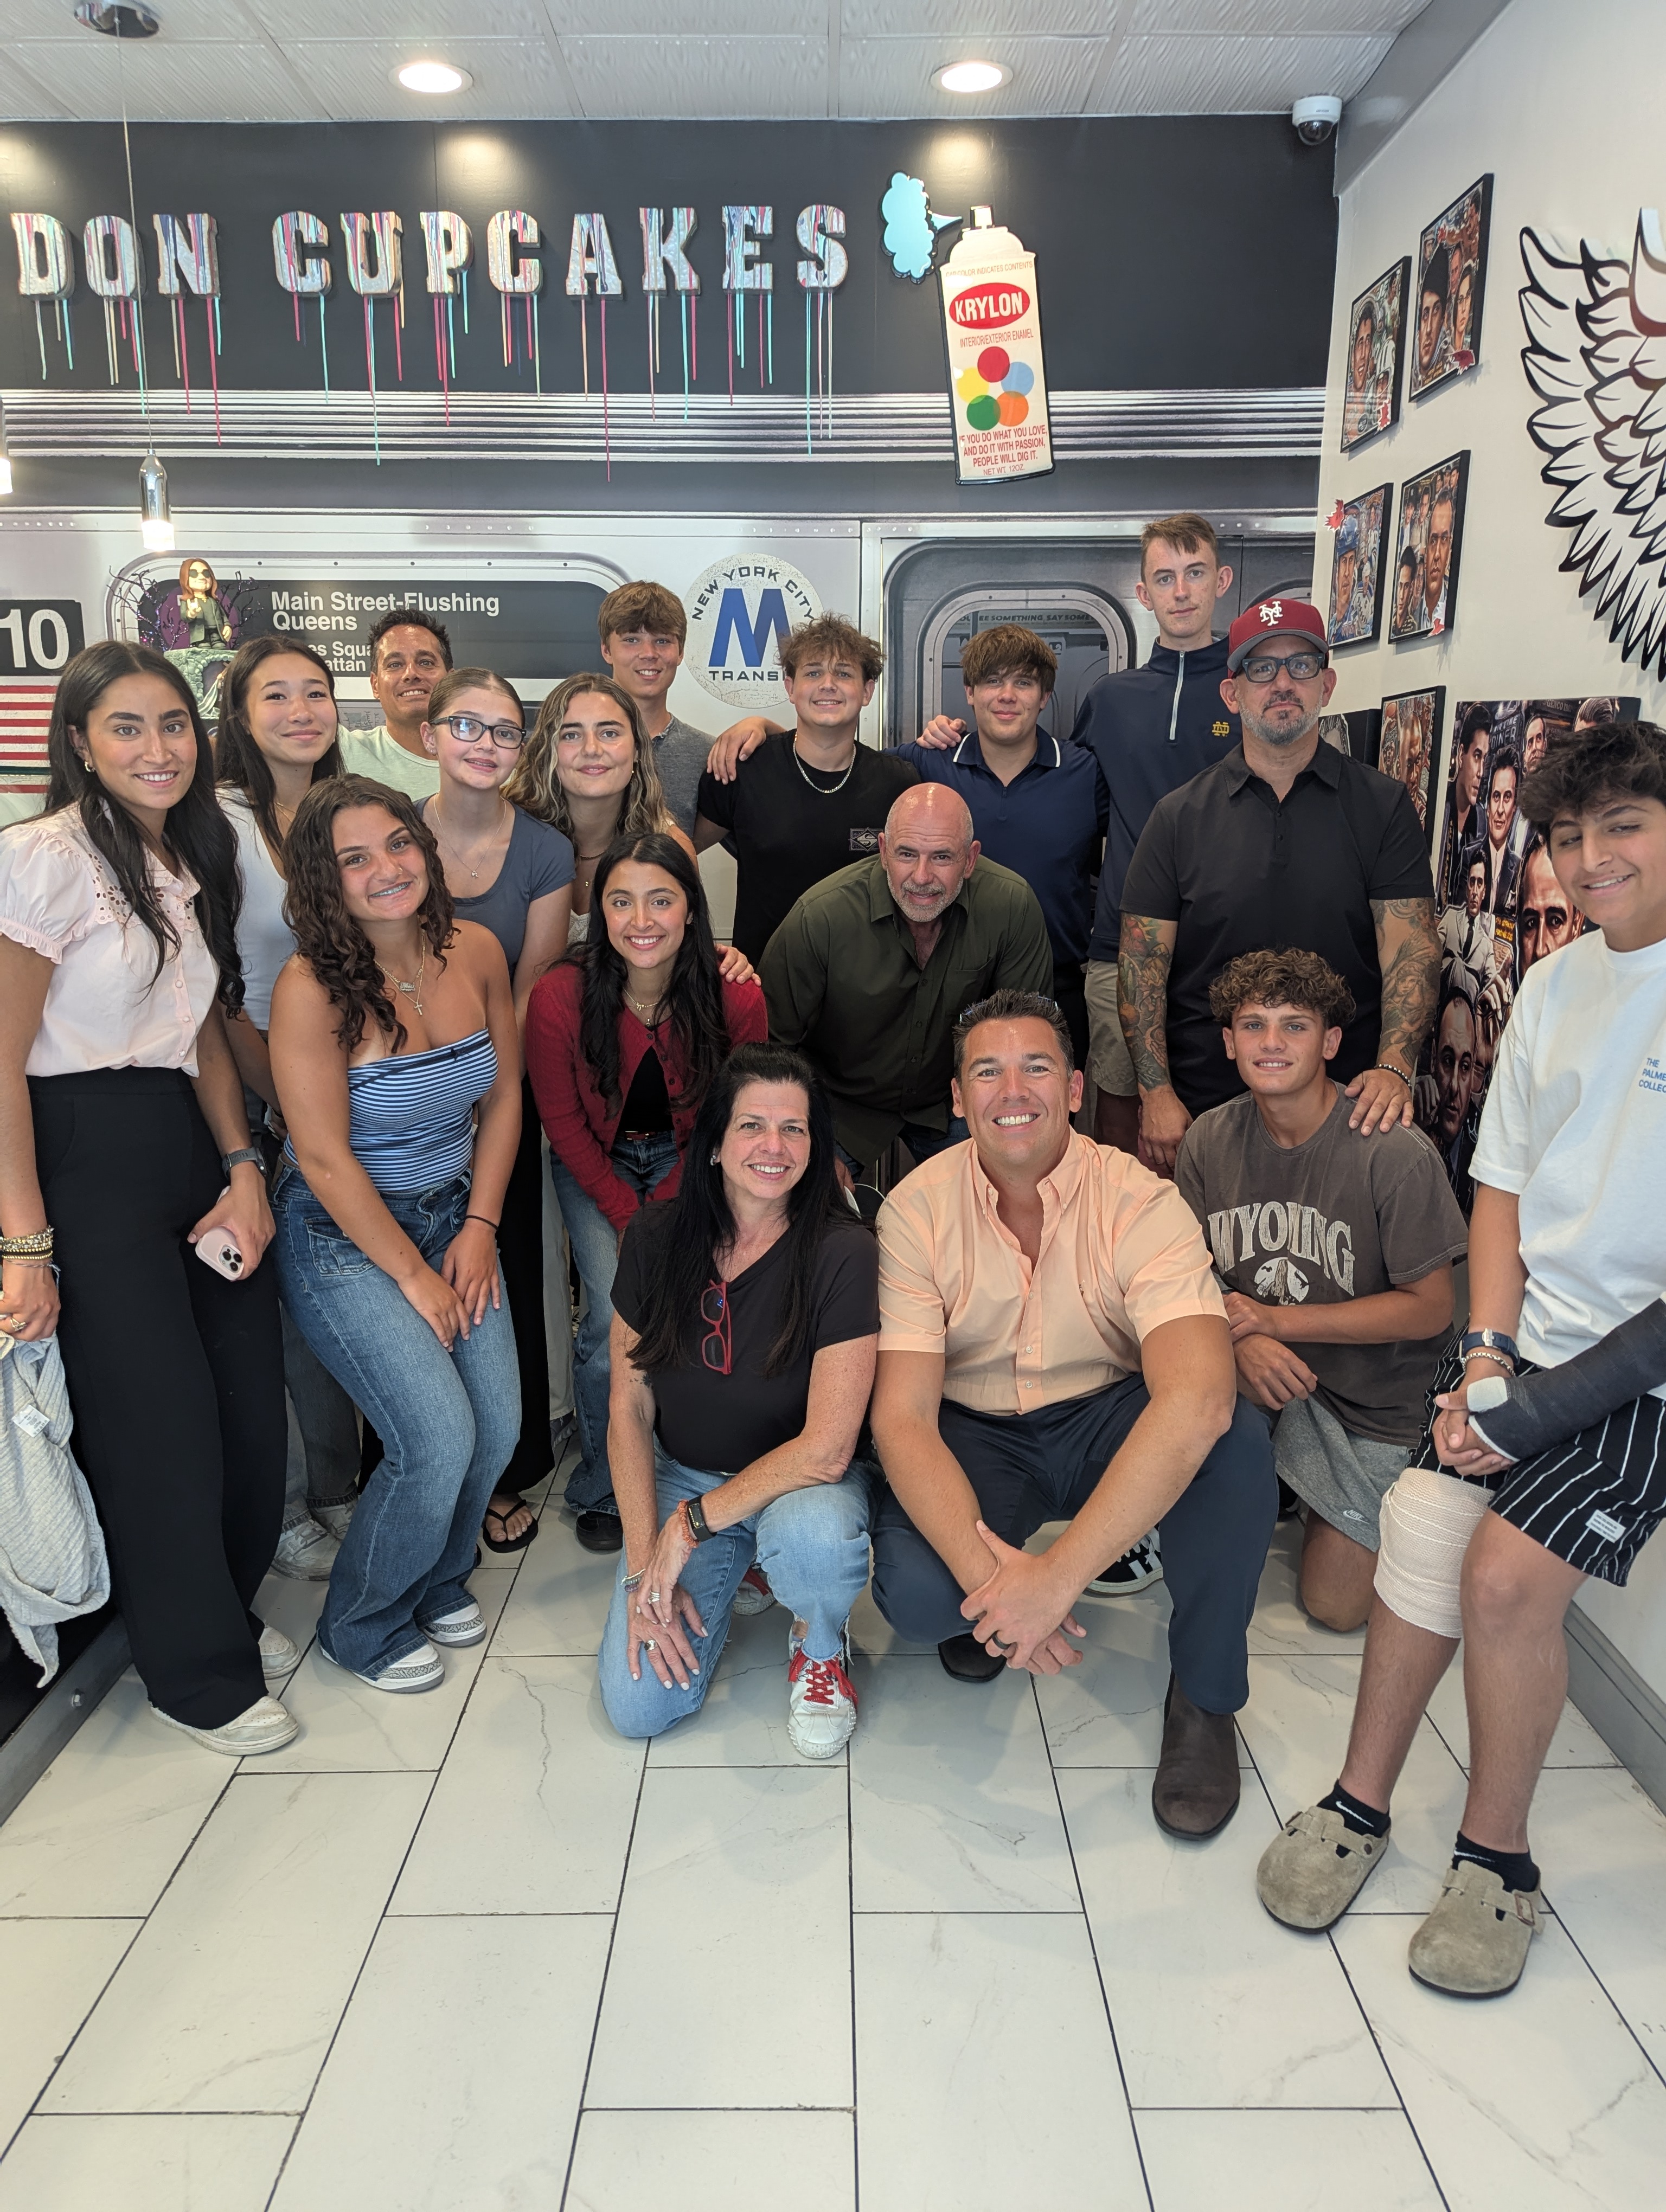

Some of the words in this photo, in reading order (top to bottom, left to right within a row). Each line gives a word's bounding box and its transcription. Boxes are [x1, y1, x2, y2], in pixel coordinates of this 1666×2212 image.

[11, 213, 221, 300] DON
[272, 204, 848, 300] CUPCAKES
[977, 265, 1003, 275] INDICATES
[1005, 261, 1033, 271] CONTENTS
[954, 291, 1023, 323] KRYLON
[960, 332, 1011, 348] INTERIOR/EXTERIOR
[1013, 329, 1034, 340] ENAMEL
[967, 434, 980, 443] YOU
[982, 432, 991, 441] DO
[992, 429, 1011, 440] WHAT
[1014, 427, 1027, 438] YOU
[1030, 425, 1047, 436] LOVE,
[964, 446, 977, 456] AND
[979, 445, 988, 454] DO
[990, 443, 995, 453] IT
[996, 441, 1014, 452] WITH
[1015, 438, 1046, 449] PASSION,
[973, 455, 999, 467] PEOPLE
[1000, 453, 1016, 465] WILL
[1017, 451, 1029, 461] DIG
[272, 591, 324, 611] Main
[330, 591, 499, 617] Street-Flushing
[691, 579, 719, 620] NEW
[723, 567, 780, 582] YORK
[785, 580, 815, 624] CITY
[273, 611, 358, 632] Queens
[0, 609, 69, 669] 10
[325, 658, 366, 672] attan
[1646, 1058, 1660, 1068] THE
